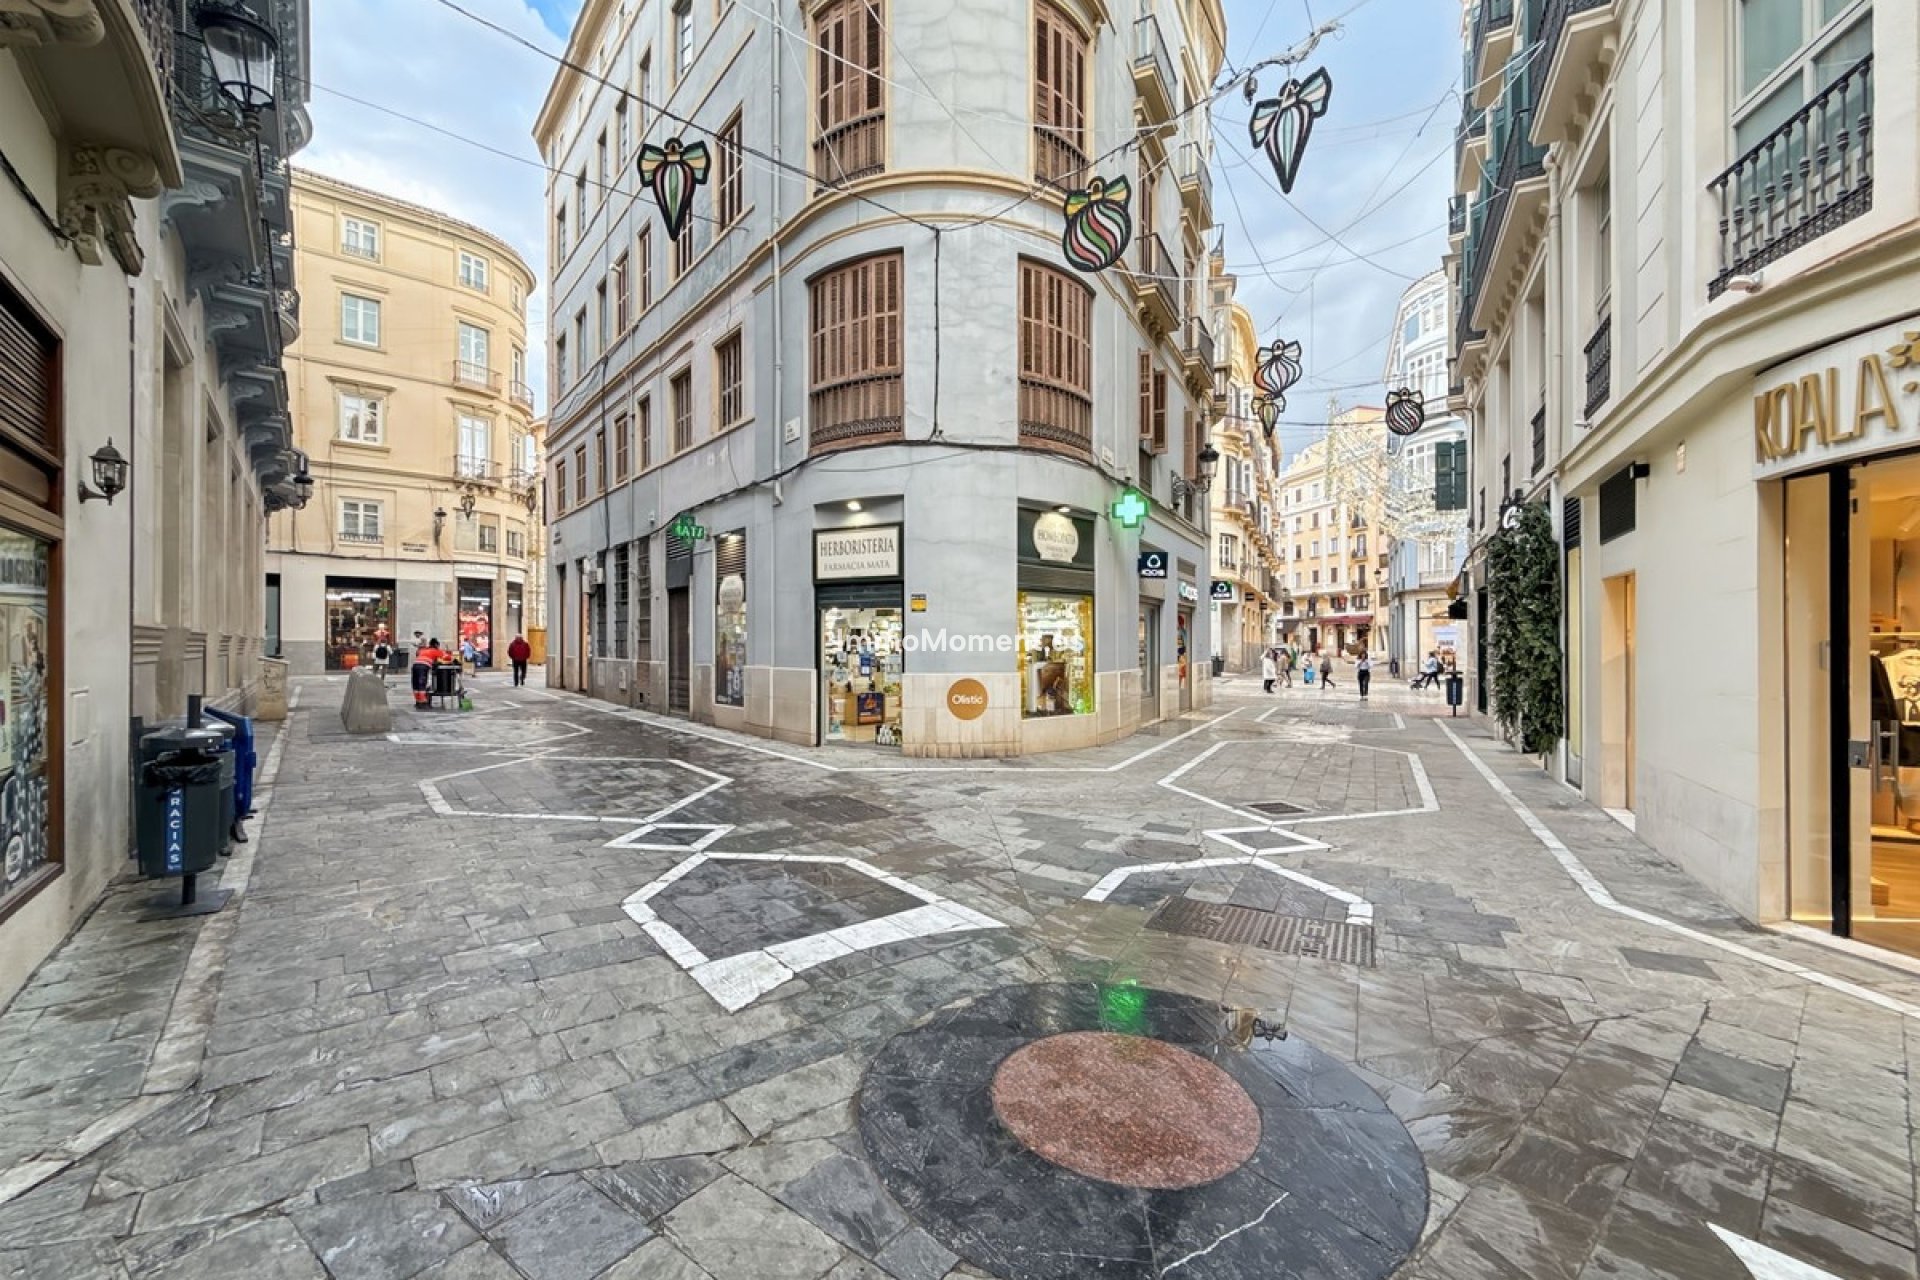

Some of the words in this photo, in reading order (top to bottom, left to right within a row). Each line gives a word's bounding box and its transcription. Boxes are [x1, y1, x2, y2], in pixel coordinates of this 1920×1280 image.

[1754, 354, 1899, 466] KOALA
[820, 537, 895, 557] HERBORISTERIA
[951, 694, 983, 705] Olistic
